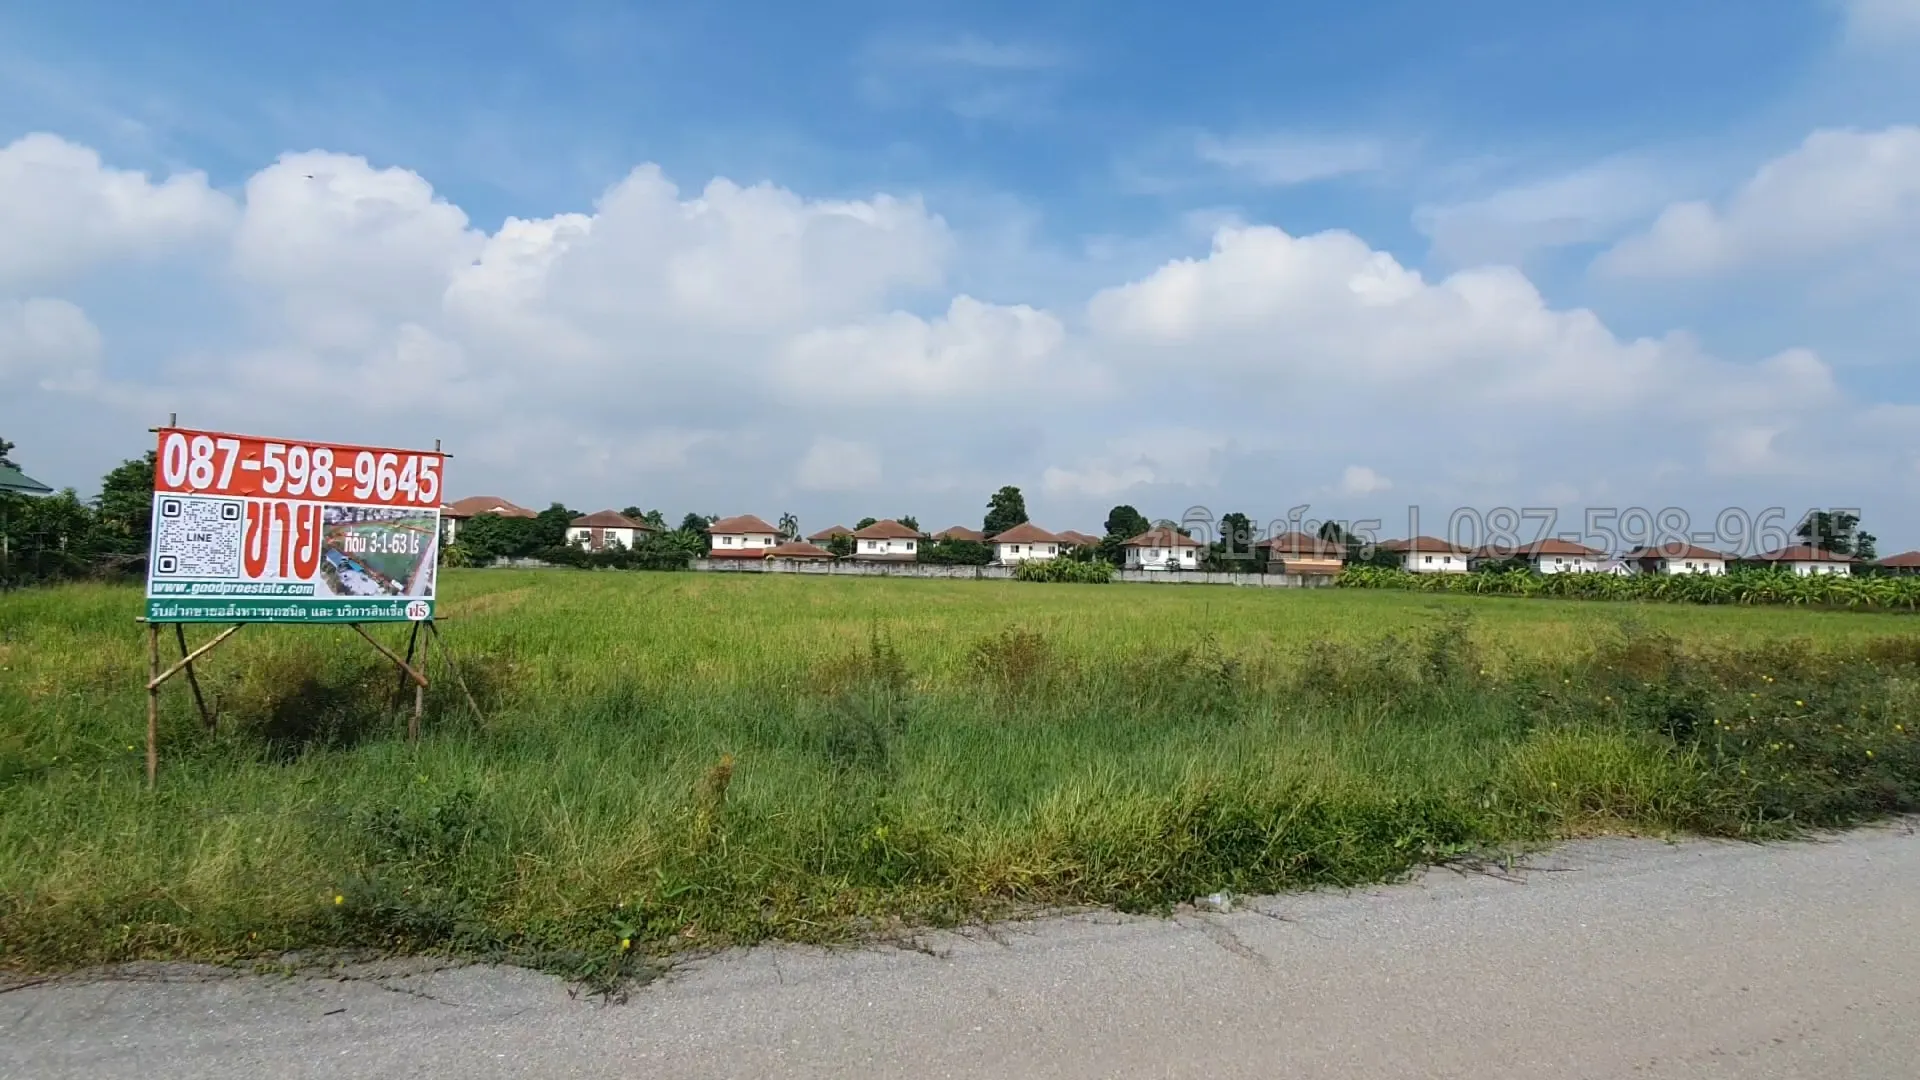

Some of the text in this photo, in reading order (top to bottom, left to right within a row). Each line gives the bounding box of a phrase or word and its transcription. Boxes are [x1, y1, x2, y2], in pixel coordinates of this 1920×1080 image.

[162, 432, 440, 504] 087-598-9645
[186, 532, 213, 543] LINE
[243, 501, 322, 580] ขาย
[344, 526, 420, 554] ที่ดิน 3-1-63 ไร่
[152, 582, 314, 596] www.goodproestate.com
[311, 606, 333, 617] และ
[336, 600, 404, 617] บริการสินเชื่อ
[408, 603, 428, 617] ฟรี
